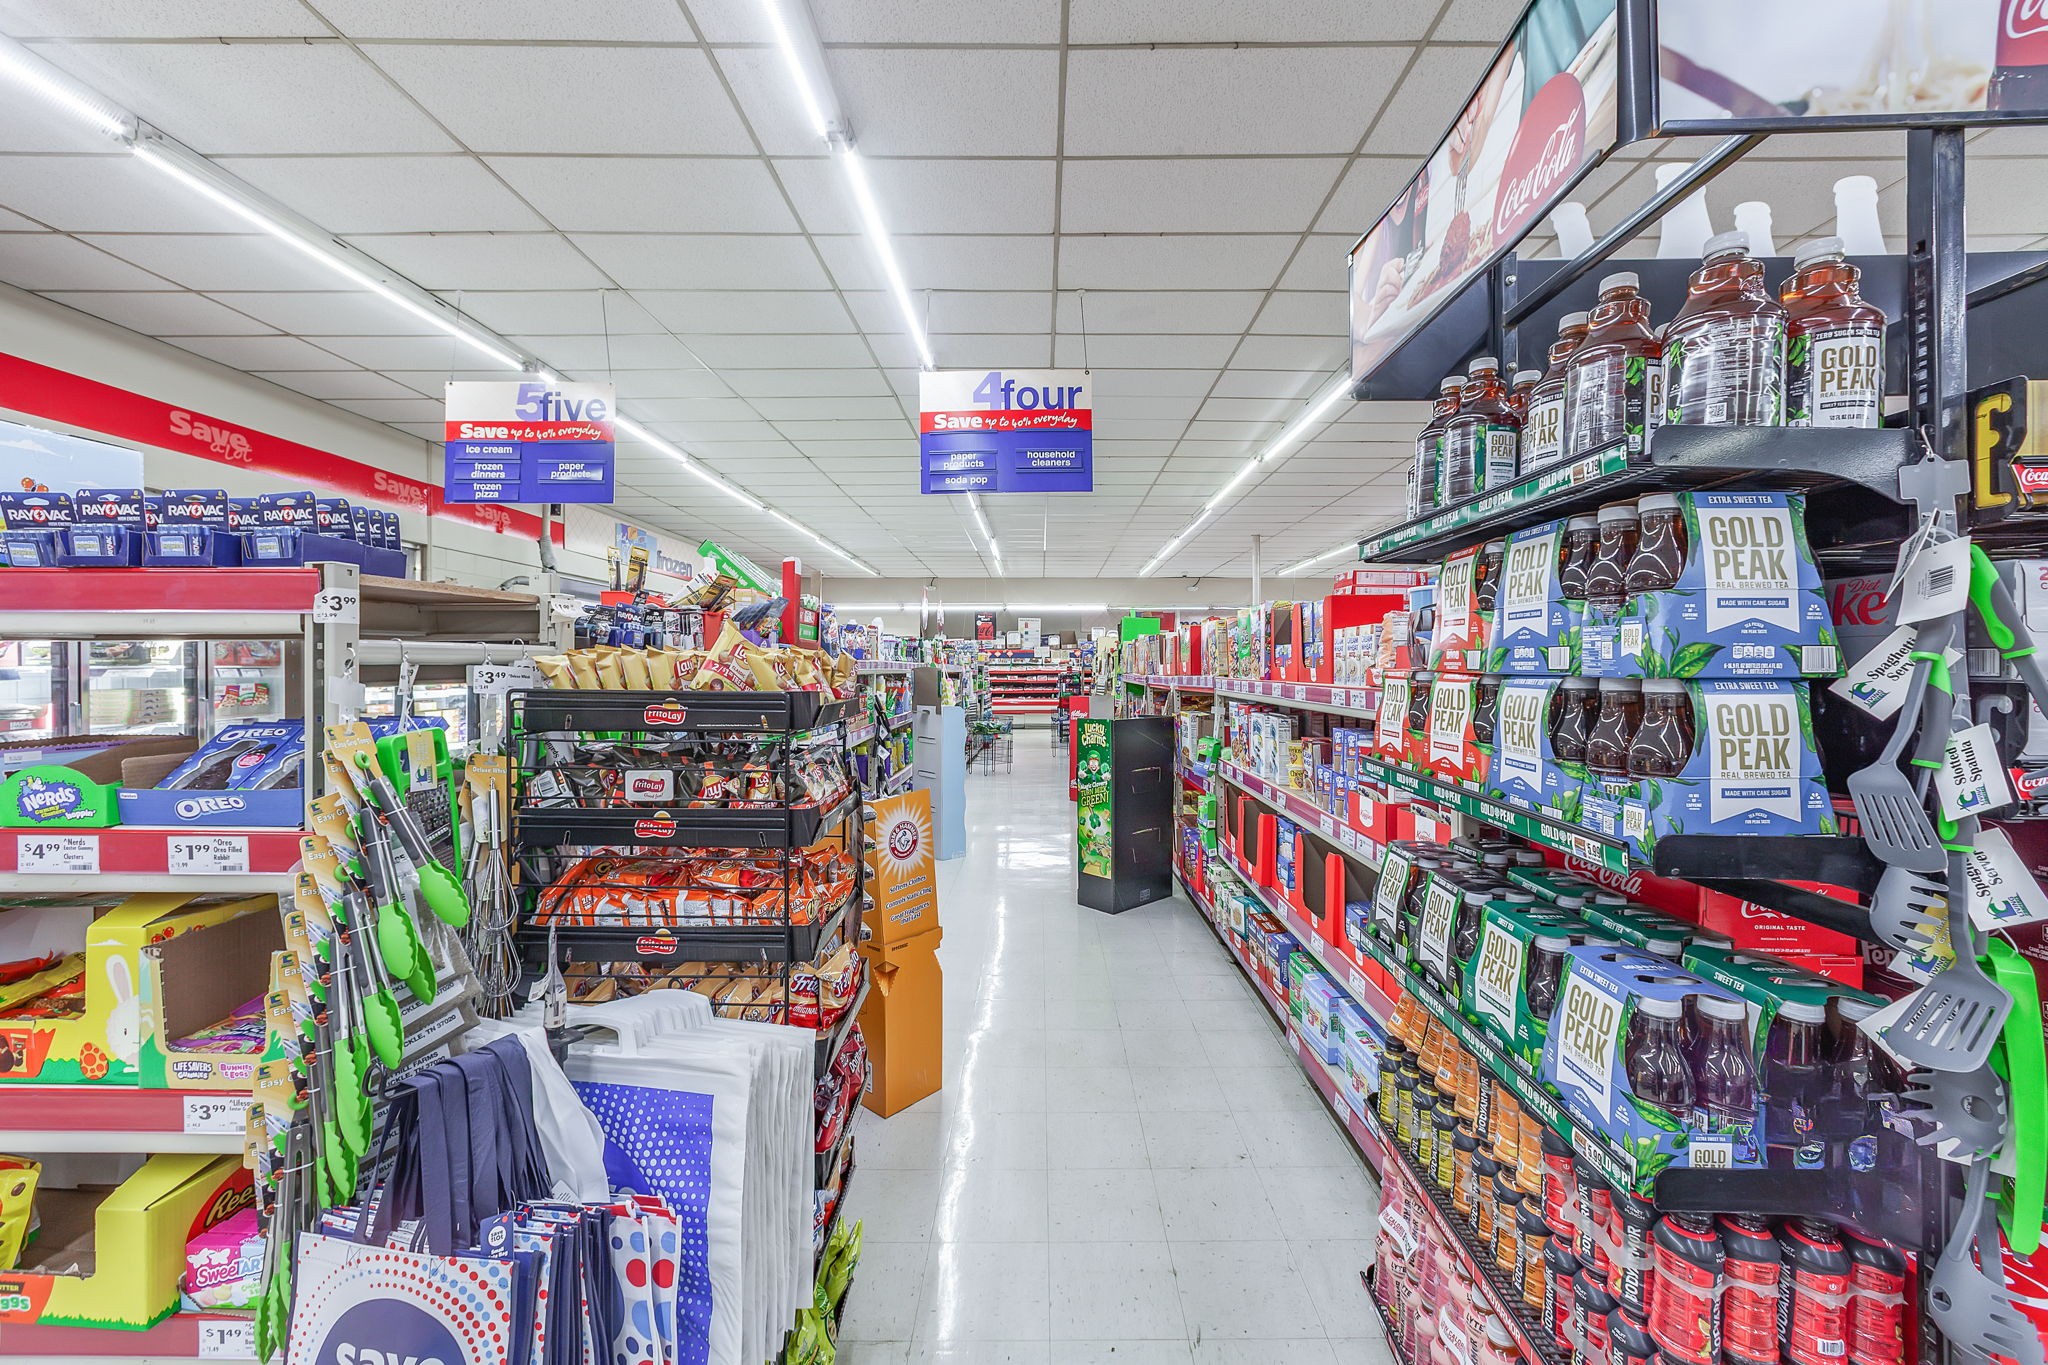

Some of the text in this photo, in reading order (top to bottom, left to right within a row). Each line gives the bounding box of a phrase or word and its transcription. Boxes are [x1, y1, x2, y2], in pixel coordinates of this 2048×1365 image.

[1820, 346, 1876, 368] GOLD
[1820, 368, 1876, 392] PEAK
[170, 410, 248, 450] Save
[934, 412, 1078, 429] Save up to 40% everyday
[460, 424, 602, 440] Save up to 40% everyday
[1491, 434, 1514, 446] GOLD
[482, 446, 513, 454] cream
[950, 452, 976, 461] paper
[1027, 450, 1076, 459] household
[1491, 446, 1514, 458] PEAK
[474, 462, 504, 471] frozen
[558, 463, 585, 472] paper
[944, 459, 984, 470] products
[1032, 458, 1072, 467] cleaners
[470, 470, 506, 479] dinners
[945, 476, 988, 486] soda pop
[473, 482, 502, 491] frozen
[475, 490, 498, 499] pizza
[82, 504, 140, 516] RAYOVAC
[168, 504, 224, 516] RAYOVAC
[1708, 496, 1773, 504] EXTRA SWEET TEA
[7, 508, 72, 522] RAYOVAC
[264, 508, 313, 522] RAYOVAC
[1708, 516, 1784, 548] GOLD
[656, 552, 693, 578] frozen
[1511, 542, 1549, 573] GOLD
[1712, 549, 1787, 580] PEAK
[1444, 562, 1468, 587] GOLD
[1508, 569, 1544, 599] PEAK
[1849, 578, 1880, 592] Diet
[1444, 584, 1467, 608] PEAK
[1624, 628, 1639, 638] GOLD
[1624, 638, 1639, 647] PEAK
[1866, 637, 1916, 680] Spaghetti
[1386, 682, 1406, 704] GOLD
[1714, 681, 1779, 690] EXTRA SWEET TEA
[1436, 688, 1466, 710] GOLD
[1503, 694, 1540, 721] GOLD
[1382, 702, 1403, 724] PEAK
[1433, 710, 1465, 733] PEAK
[1716, 703, 1790, 737] GOLD
[219, 727, 288, 743] OREO
[1082, 734, 1106, 747] Charms
[1084, 723, 1106, 736] Lucky
[1504, 719, 1536, 748] PEAK
[1720, 738, 1791, 770] PEAK
[1962, 740, 1982, 783] Spatula
[1946, 746, 1966, 786] Slotted
[176, 796, 246, 819] OREO
[1480, 801, 1516, 826] GOLD PEAK
[1540, 824, 1559, 840] GOLD
[1586, 842, 1600, 857] 5.99
[1386, 859, 1406, 885] GOLD
[1974, 850, 2003, 886] Server
[889, 876, 926, 894] Softens Clothes
[1380, 876, 1401, 900] PEAK
[885, 896, 906, 909] Controls
[920, 886, 932, 896] Cling
[1428, 890, 1451, 920] GOLD
[891, 902, 930, 922] Great Fragrances
[1424, 913, 1446, 944] PEAK
[1486, 930, 1518, 964] GOLD
[1480, 956, 1512, 994] PEAK
[1579, 965, 1618, 994] EXTRA SWEET TEA
[1714, 971, 1745, 992] SWEET TEA
[1568, 983, 1614, 1036] GOLD
[404, 1034, 425, 1048] CKLE,
[437, 1015, 457, 1030] 37020
[1564, 1016, 1609, 1069] PEAK
[1462, 1026, 1494, 1063] GOLD PEAK
[172, 1062, 212, 1072] LIFE SAVERS
[1478, 1076, 1490, 1134] BODYARMOR
[1516, 1077, 1558, 1124] GOLD PEAK
[1694, 1149, 1726, 1164] GOLD
[1435, 1212, 1466, 1259] BODYARMOR
[1481, 1280, 1521, 1341] BODYARMOR
[1466, 1314, 1486, 1332] LYTE
